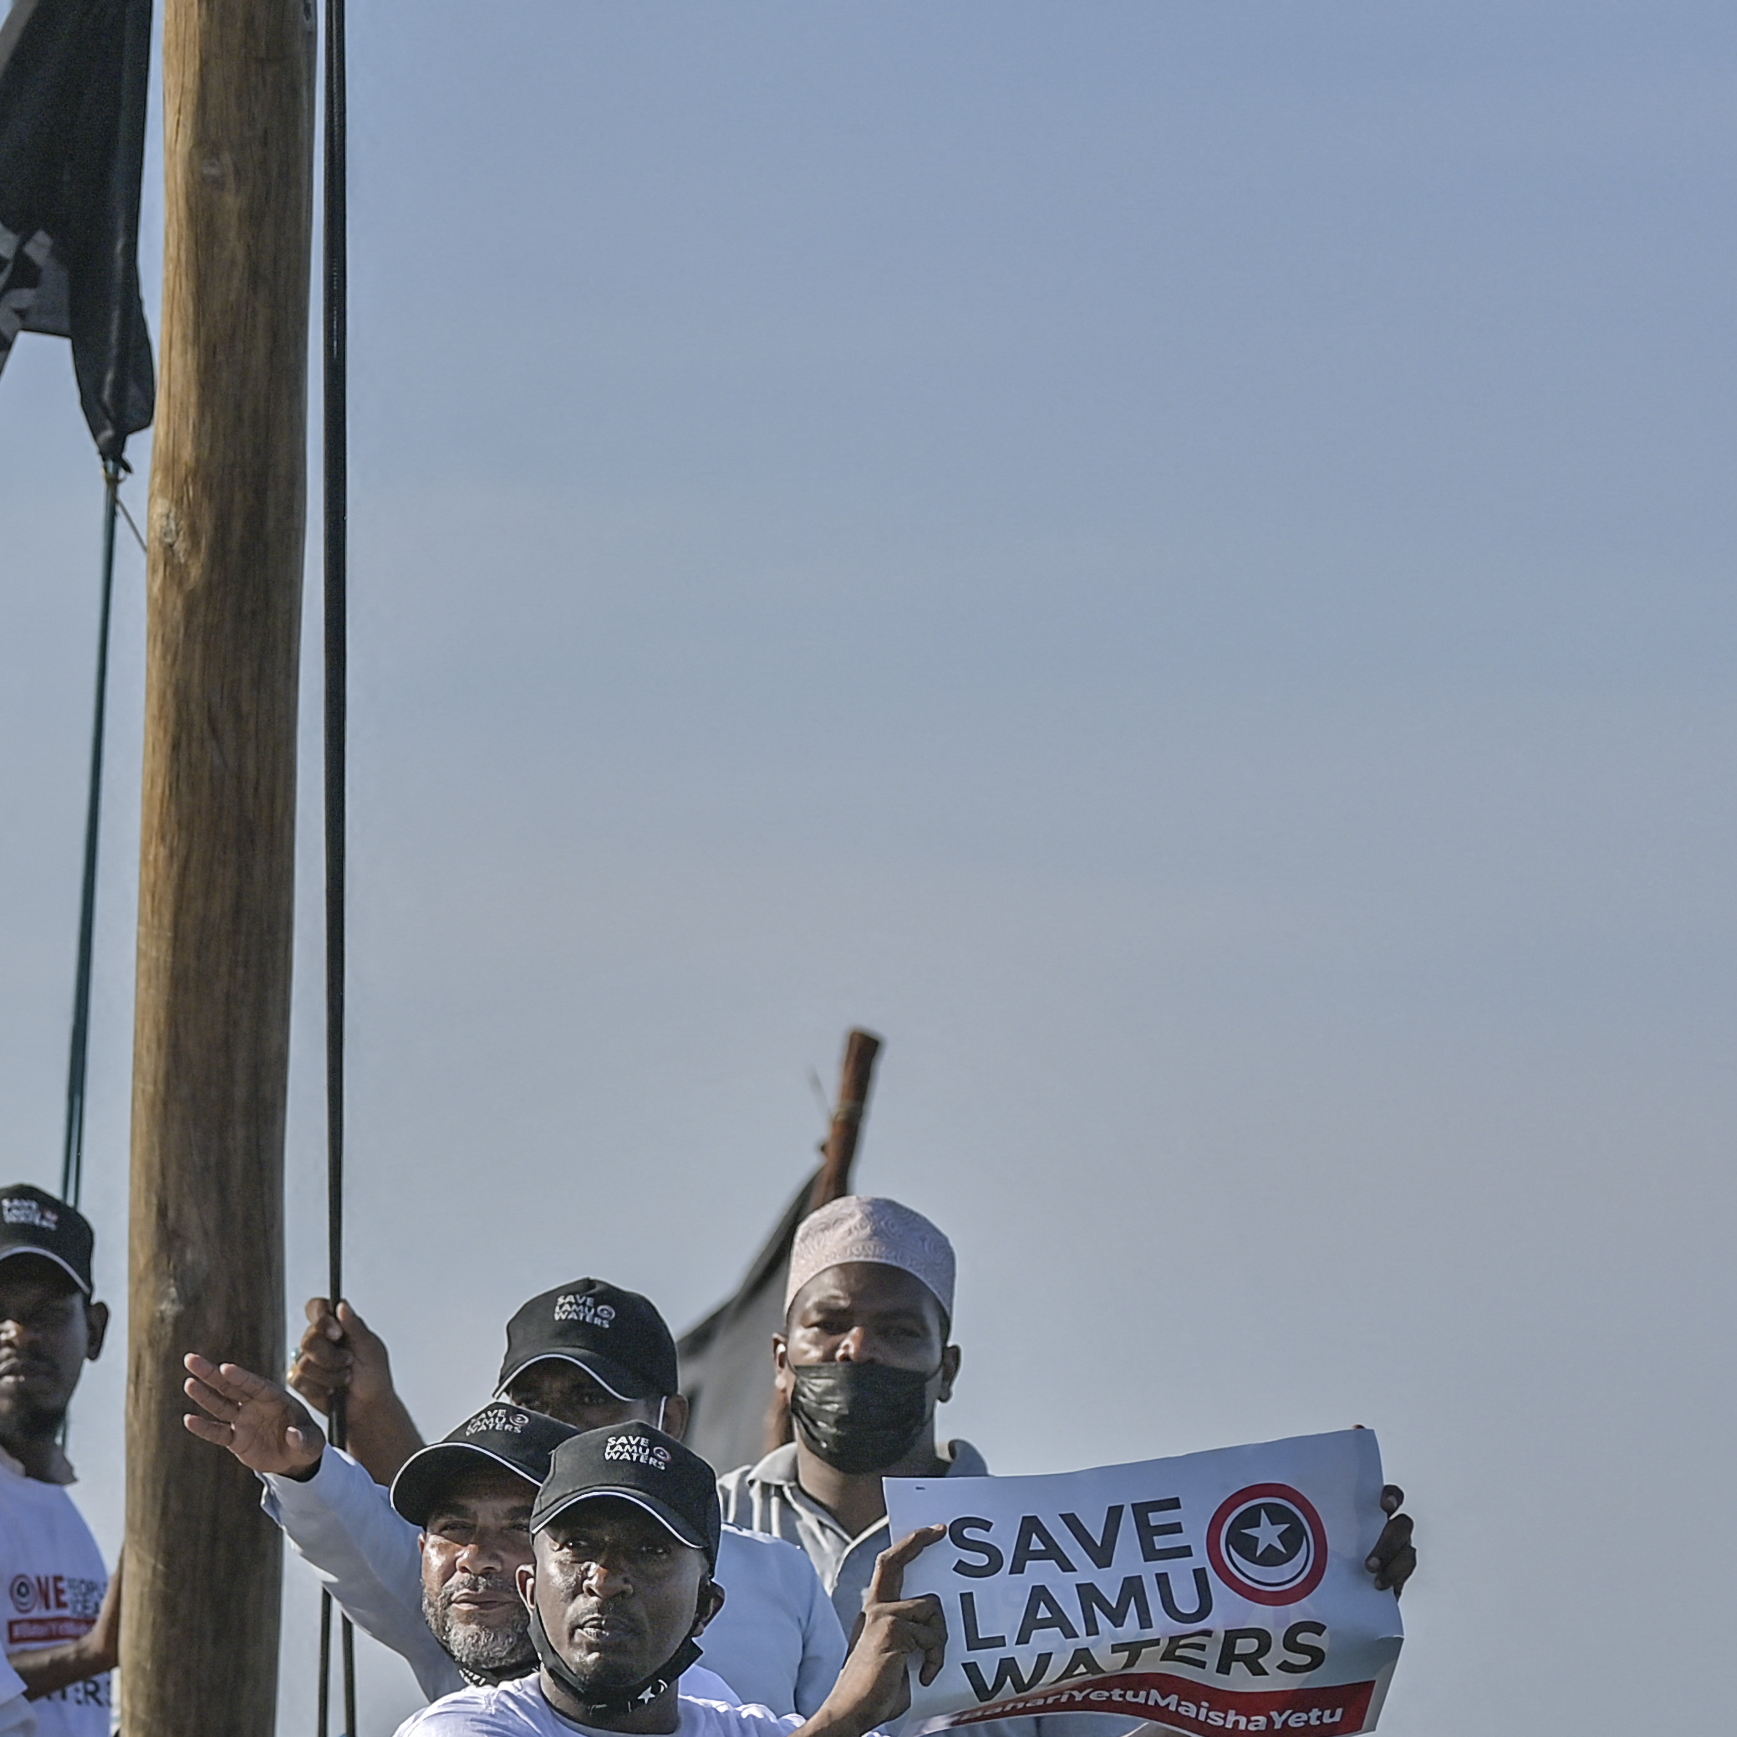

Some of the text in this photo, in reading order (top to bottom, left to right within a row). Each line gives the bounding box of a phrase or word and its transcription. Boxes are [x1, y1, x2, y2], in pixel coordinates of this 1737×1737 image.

[557, 1294, 595, 1306] SAVE
[554, 1303, 595, 1315] LAMU
[554, 1311, 610, 1329] WATERS
[470, 1409, 507, 1425] SAVE
[465, 1423, 522, 1437] WATERS
[607, 1435, 650, 1447] SAVE
[605, 1444, 650, 1455] LAMU
[604, 1451, 666, 1471] WATERS
[948, 1496, 1194, 1579] SAVE
[959, 1566, 1214, 1652] LAMU
[960, 1619, 1327, 1703] WATERS
